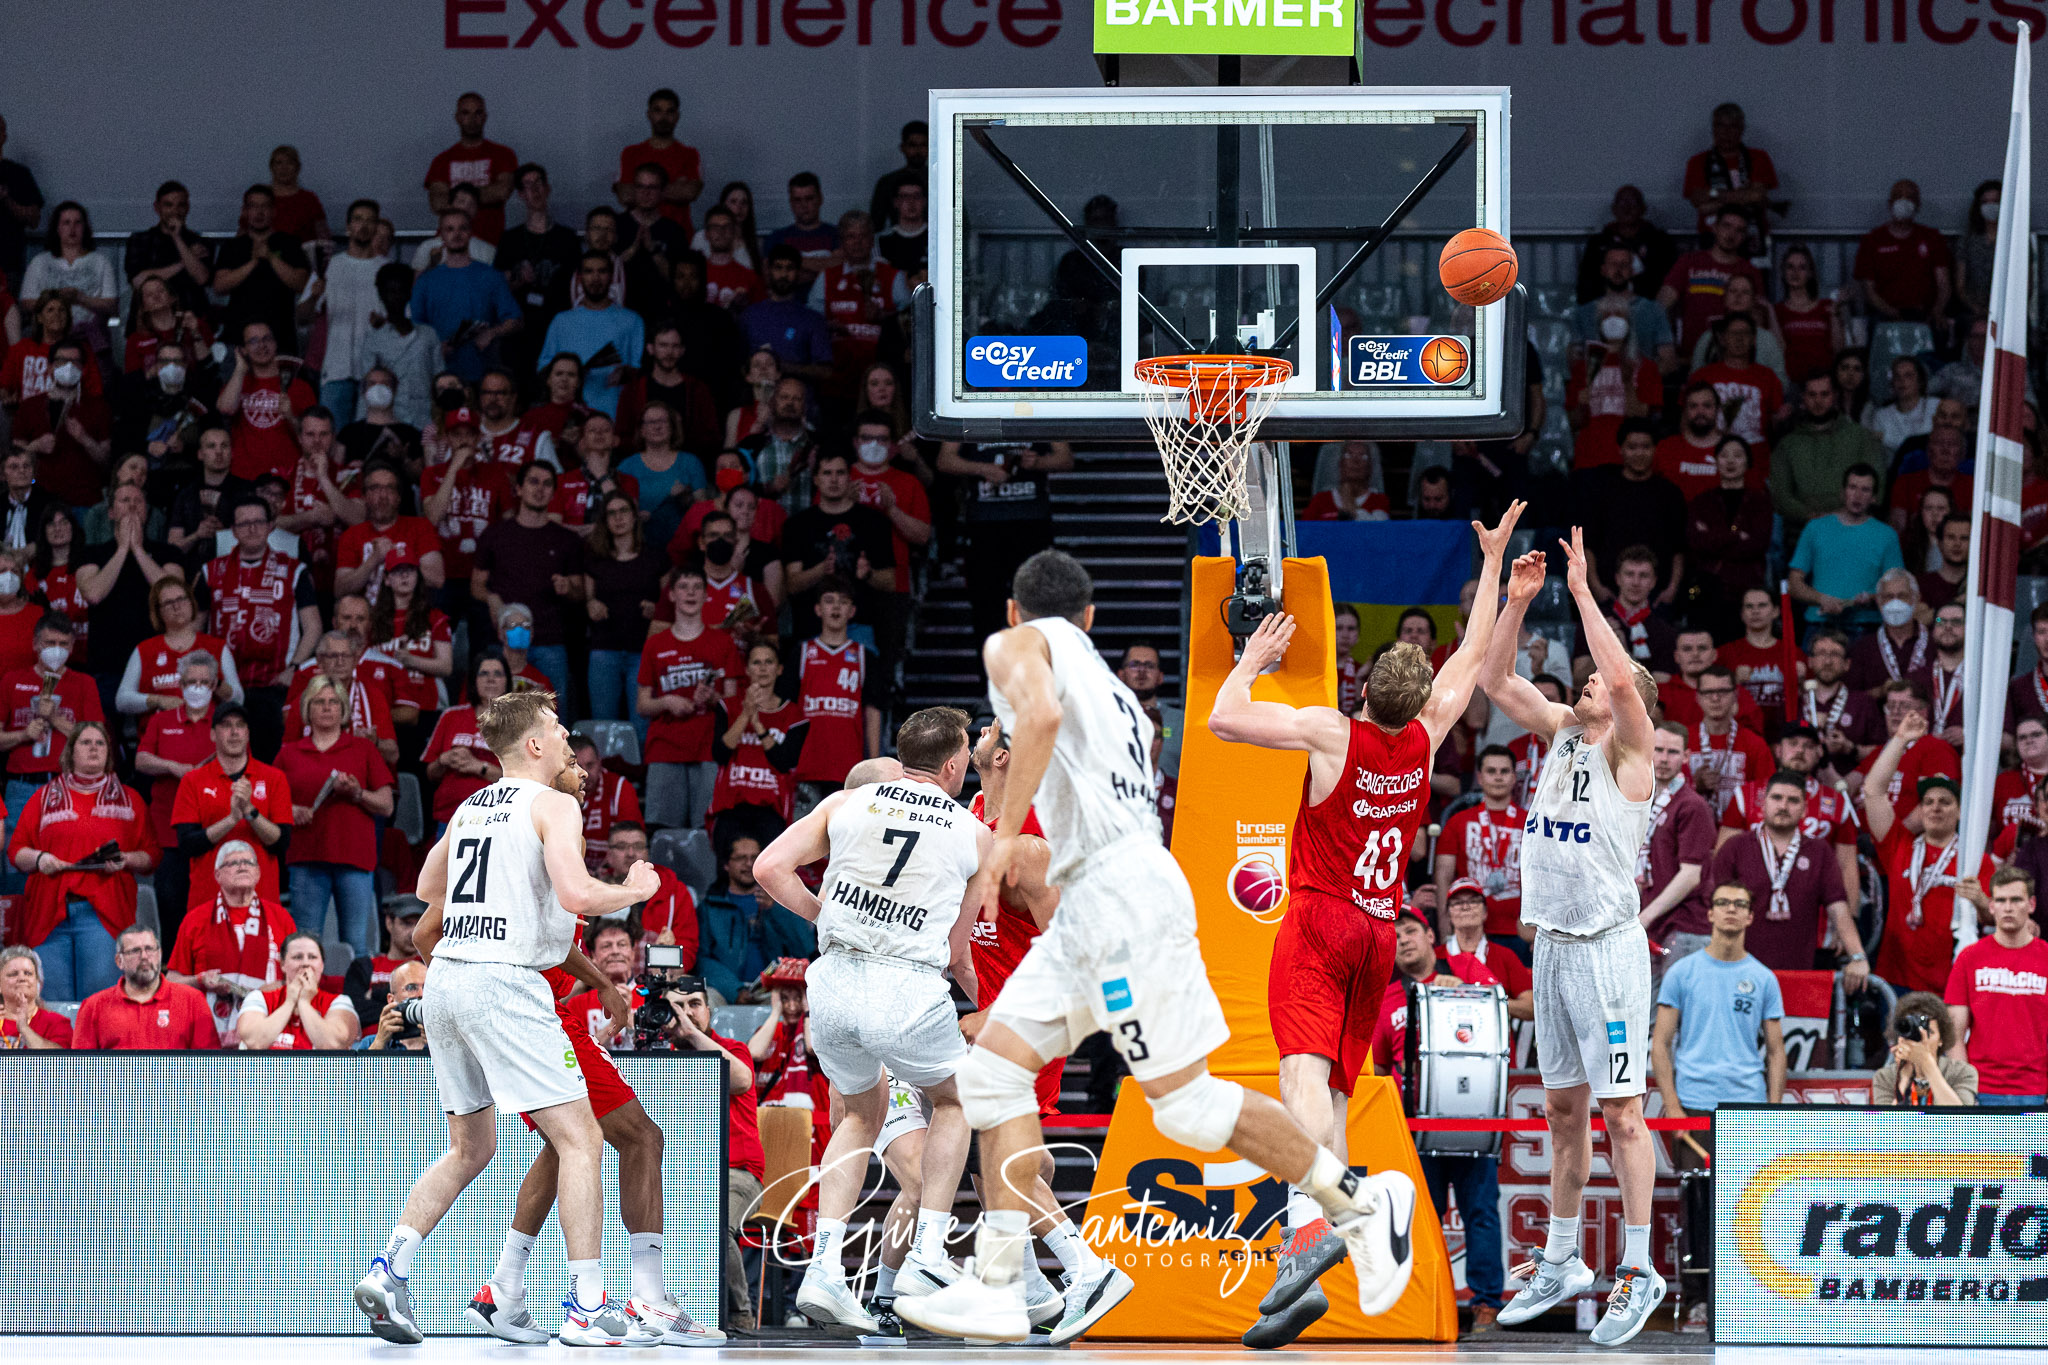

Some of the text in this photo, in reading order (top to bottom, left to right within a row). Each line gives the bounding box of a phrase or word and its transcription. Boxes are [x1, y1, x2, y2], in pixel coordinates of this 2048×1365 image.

[444, 0, 2045, 49] Excellence echatronics
[1106, 0, 1343, 28] BARMER
[1358, 361, 1408, 381] BBL
[836, 667, 860, 694] 44
[875, 784, 956, 813] MEISNER
[1571, 770, 1592, 803] 12
[908, 812, 953, 830] BLACK
[1236, 819, 1286, 835] brose
[1236, 834, 1286, 847] bamberg
[452, 836, 492, 904] 21
[881, 827, 921, 888] 7
[1352, 826, 1403, 891] 43
[831, 880, 929, 932] HAMBURG
[1733, 999, 1752, 1015] 92
[1119, 1019, 1150, 1062] 3
[1608, 1052, 1631, 1084] 12
[1799, 1183, 2048, 1260] radio
[1818, 1278, 2010, 1301] BAMBERG
